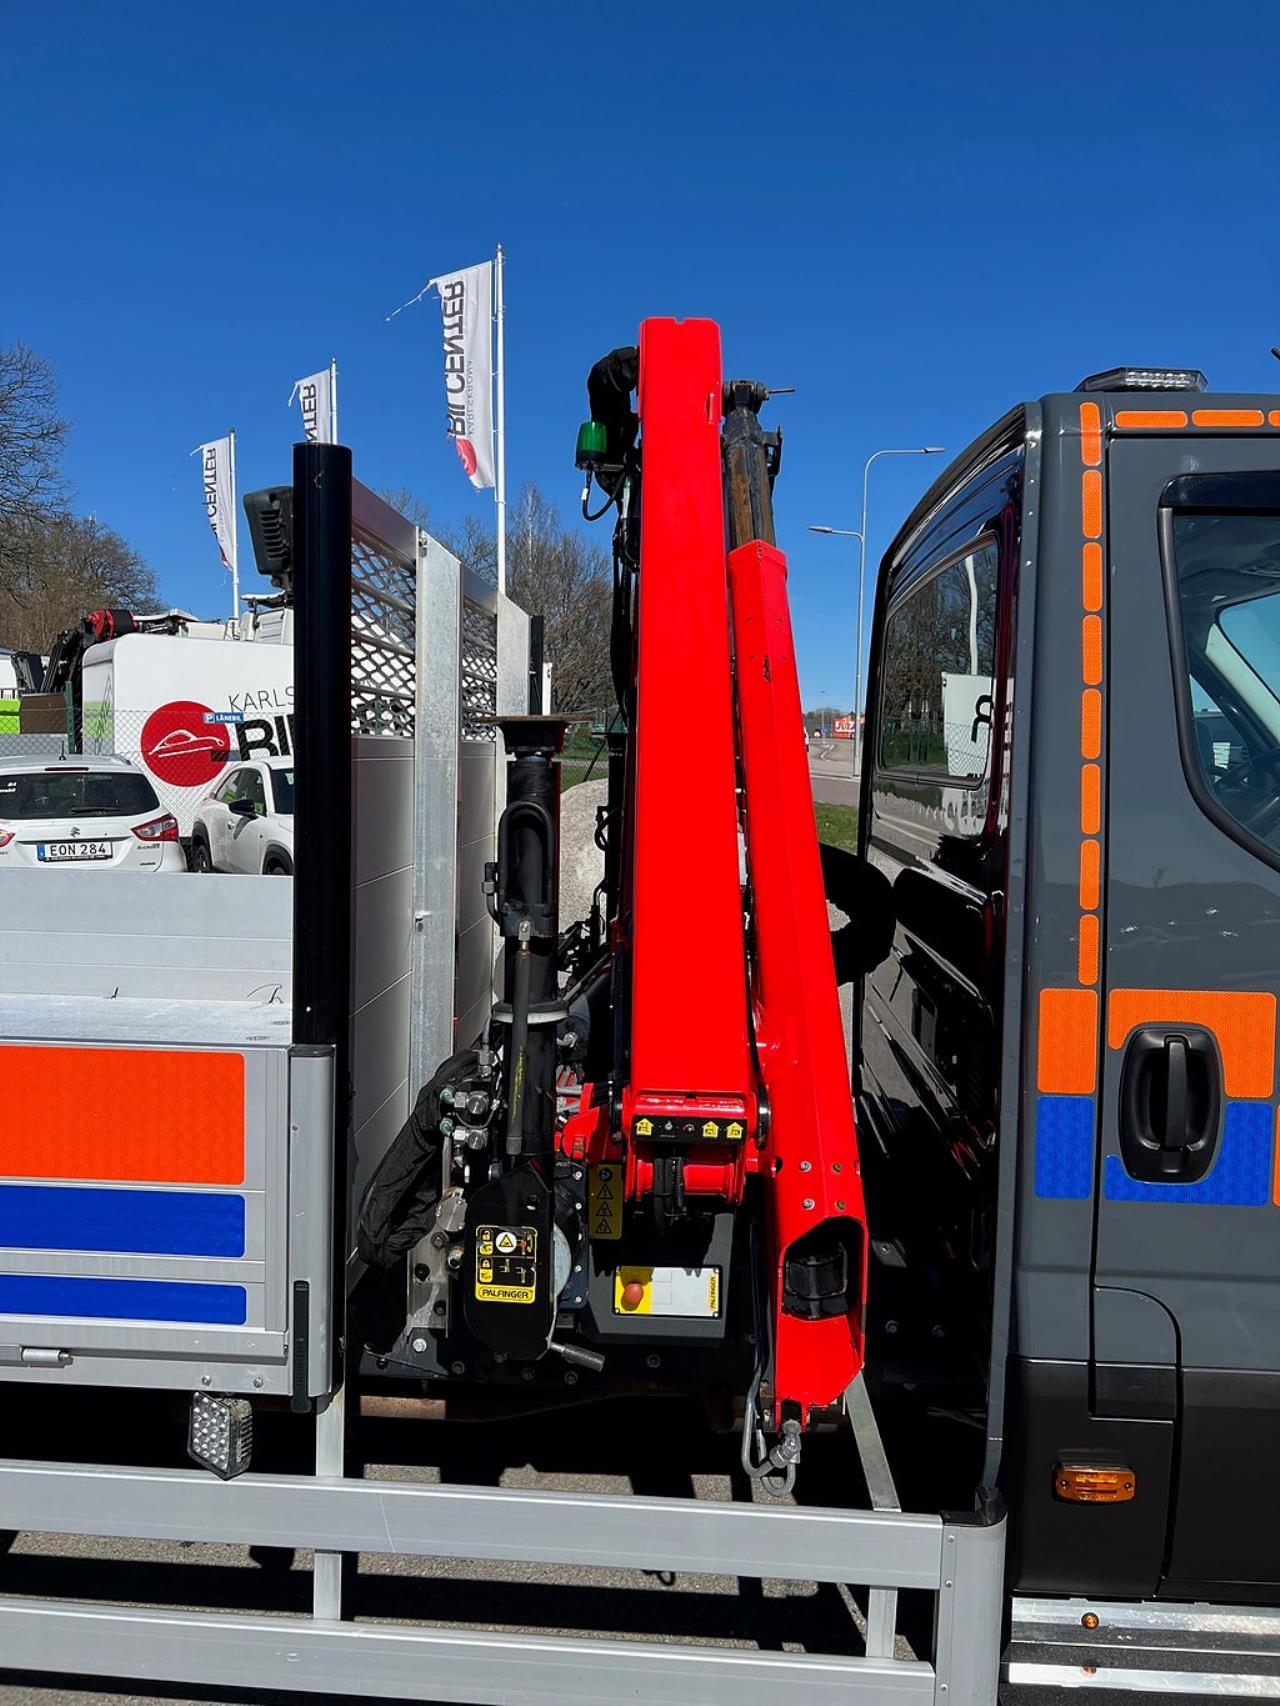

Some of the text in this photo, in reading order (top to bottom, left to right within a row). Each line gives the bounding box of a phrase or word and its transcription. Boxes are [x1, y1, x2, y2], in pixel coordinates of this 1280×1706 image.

[50, 842, 106, 856] EON 284
[482, 1288, 529, 1299] PALFINGER
